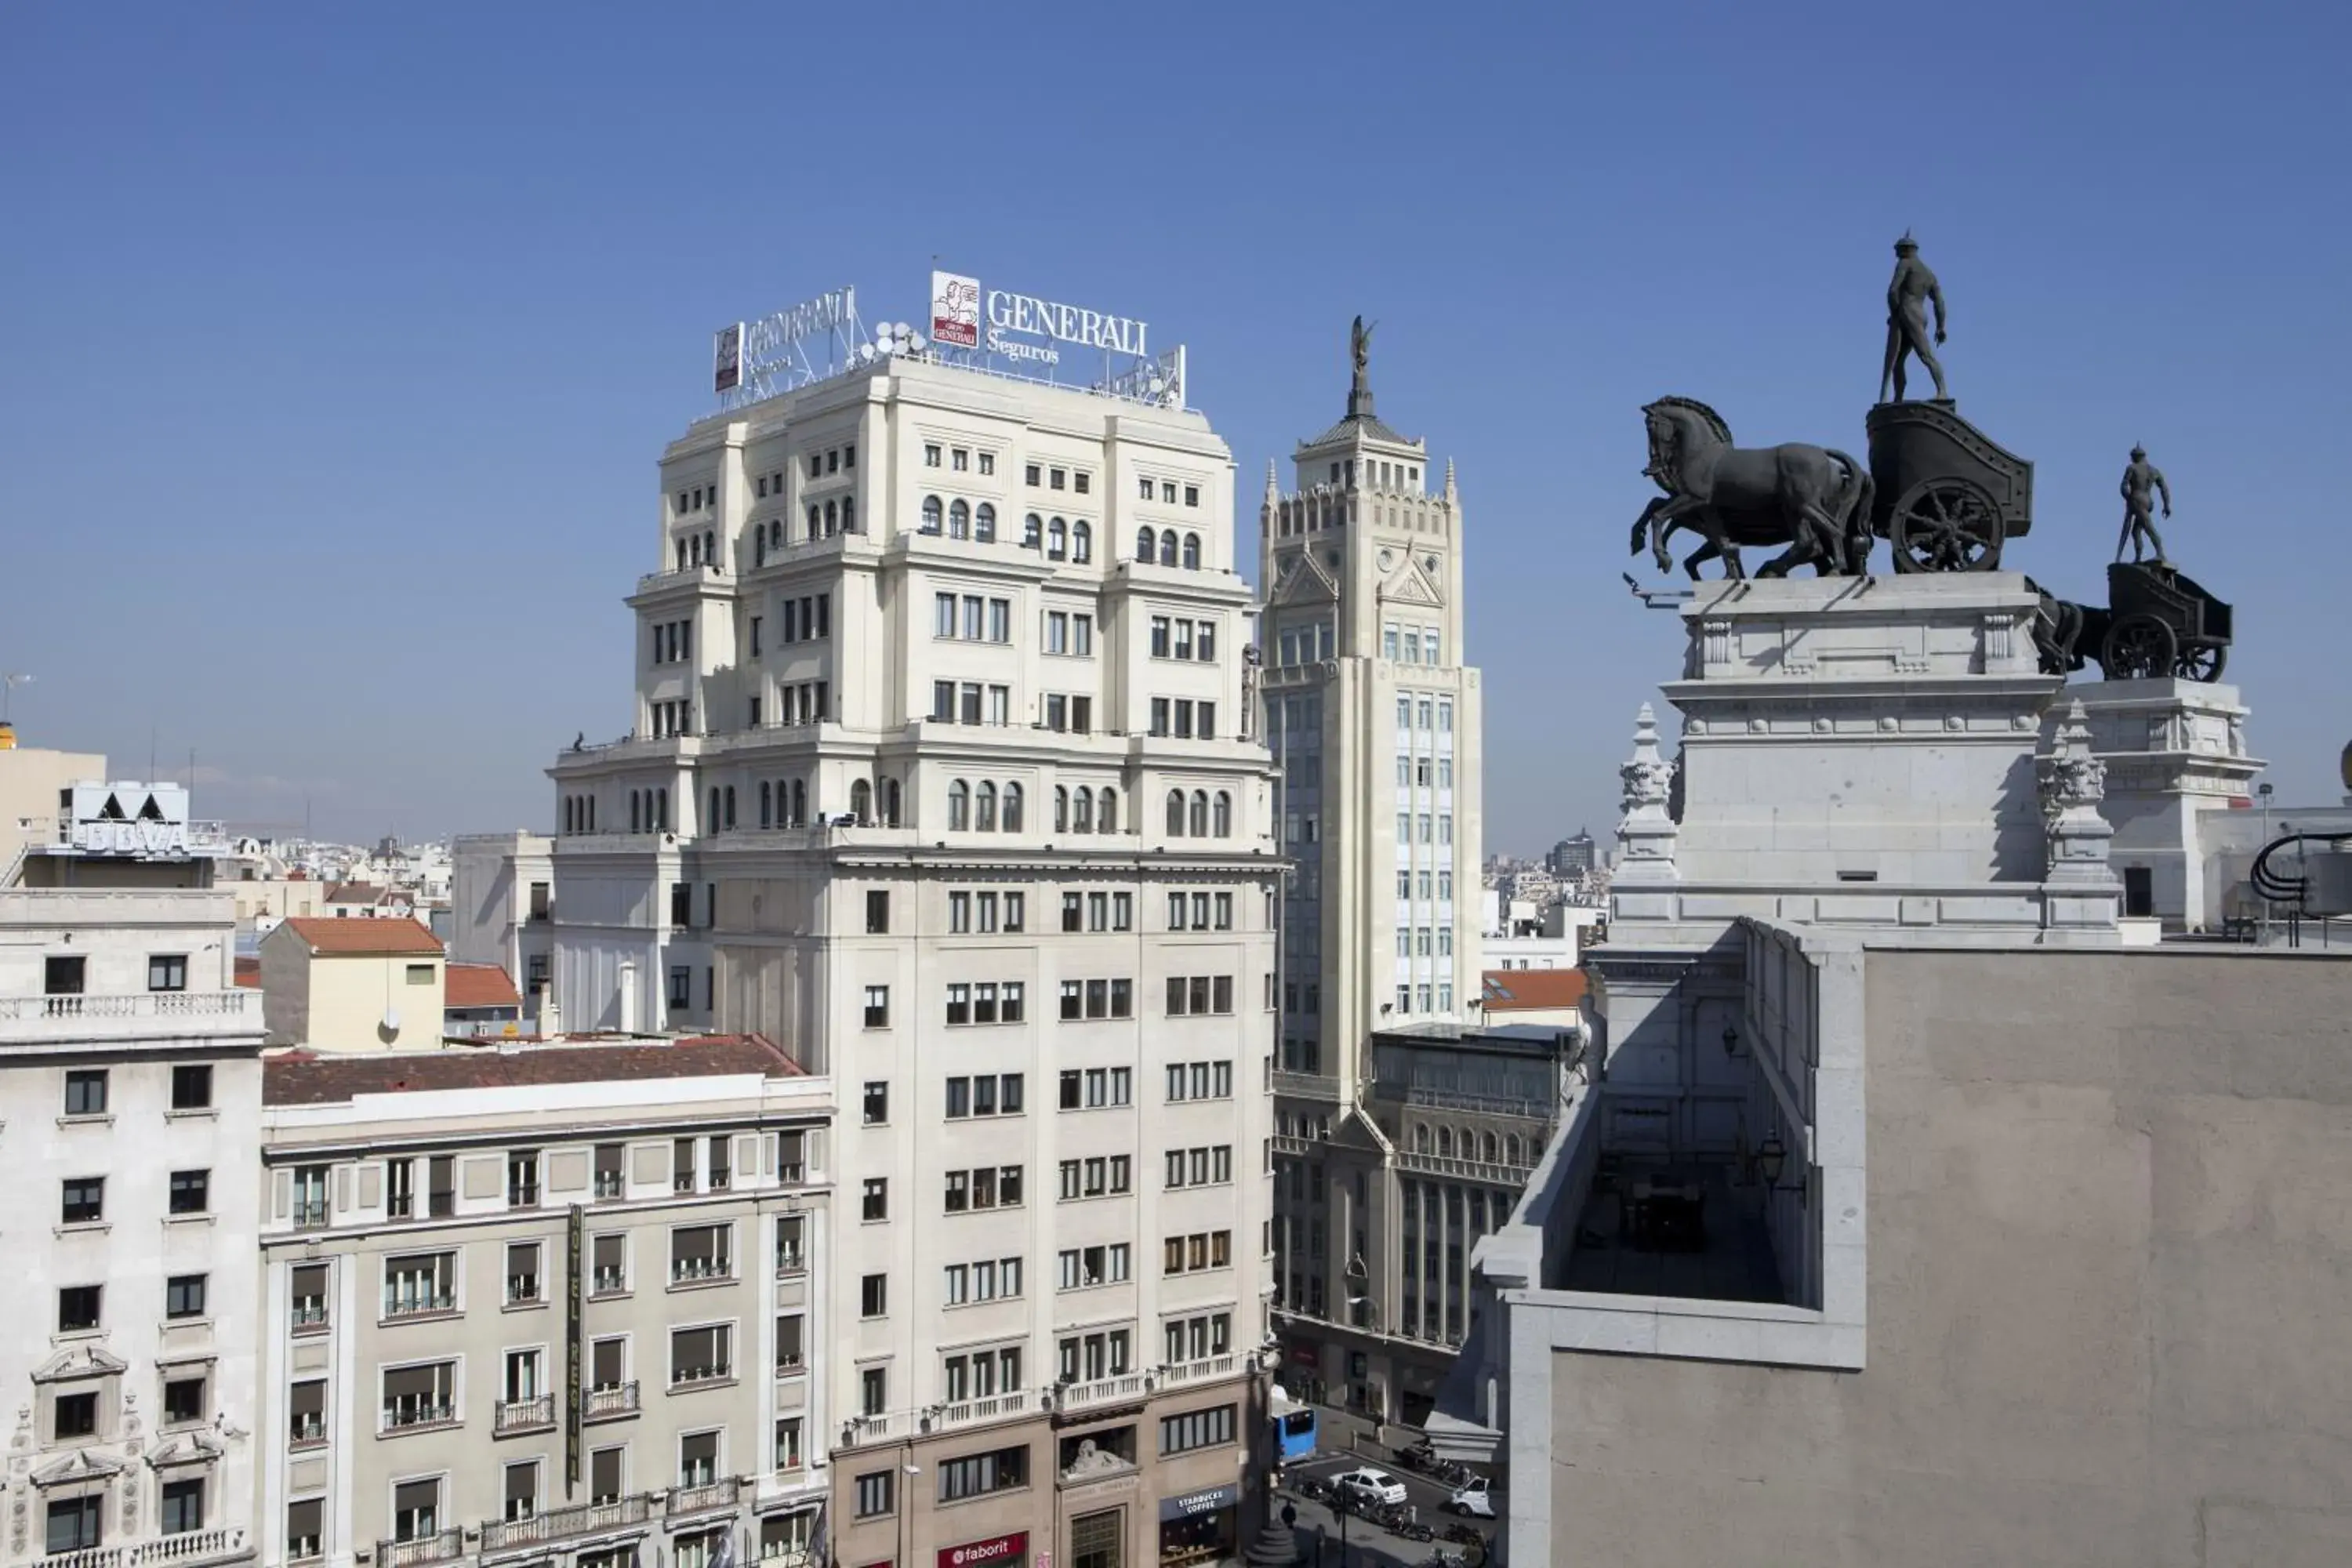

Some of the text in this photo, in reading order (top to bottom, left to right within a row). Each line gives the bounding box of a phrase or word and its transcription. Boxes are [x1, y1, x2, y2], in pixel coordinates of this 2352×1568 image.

[935, 328, 975, 344] GENERALI
[988, 290, 1148, 356] GENERALI
[987, 327, 1059, 365] Seguros
[570, 1341, 579, 1479] REGINA
[965, 1540, 1008, 1561] faborit
